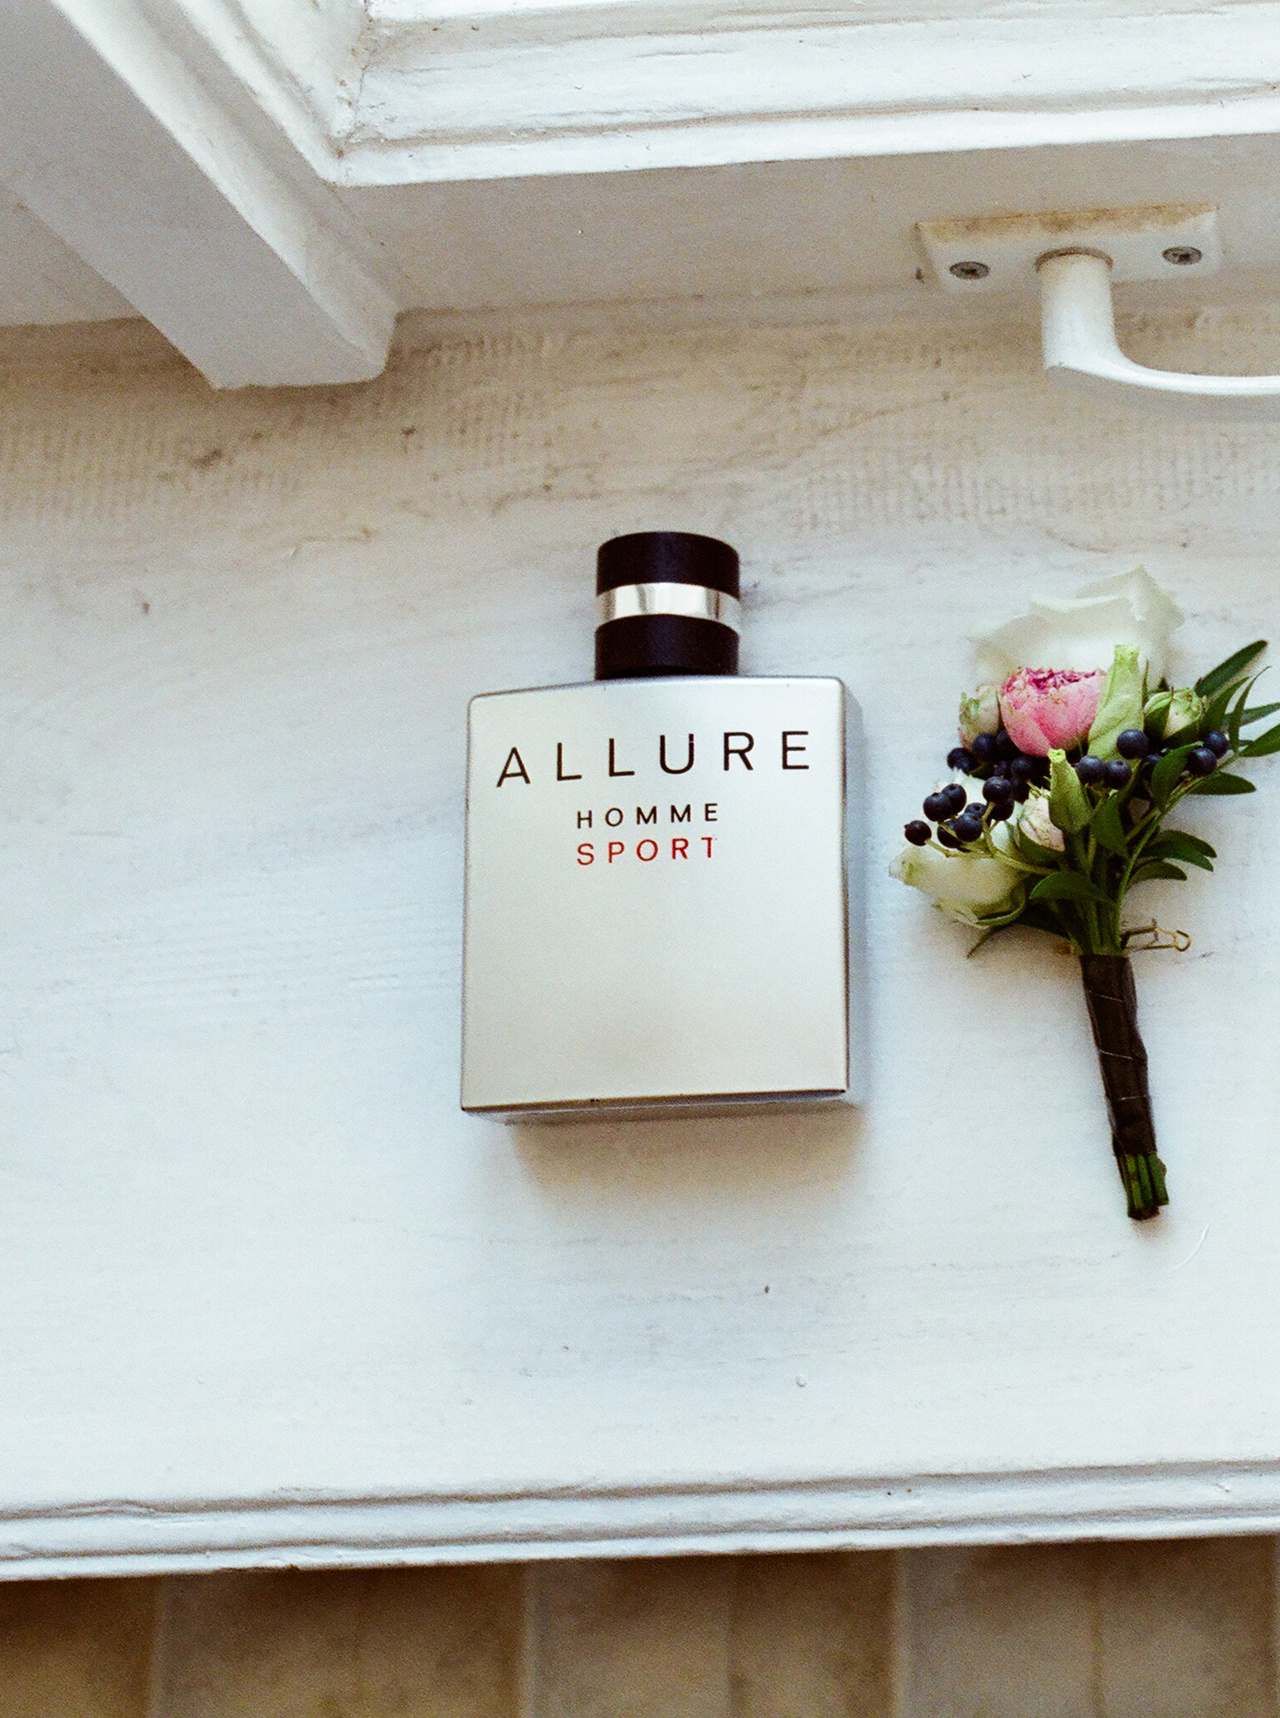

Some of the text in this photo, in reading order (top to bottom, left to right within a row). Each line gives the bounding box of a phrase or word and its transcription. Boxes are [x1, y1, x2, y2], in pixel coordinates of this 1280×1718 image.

[496, 730, 810, 788] ALLURE
[576, 803, 718, 829] HOMME
[576, 836, 717, 866] SPORT
